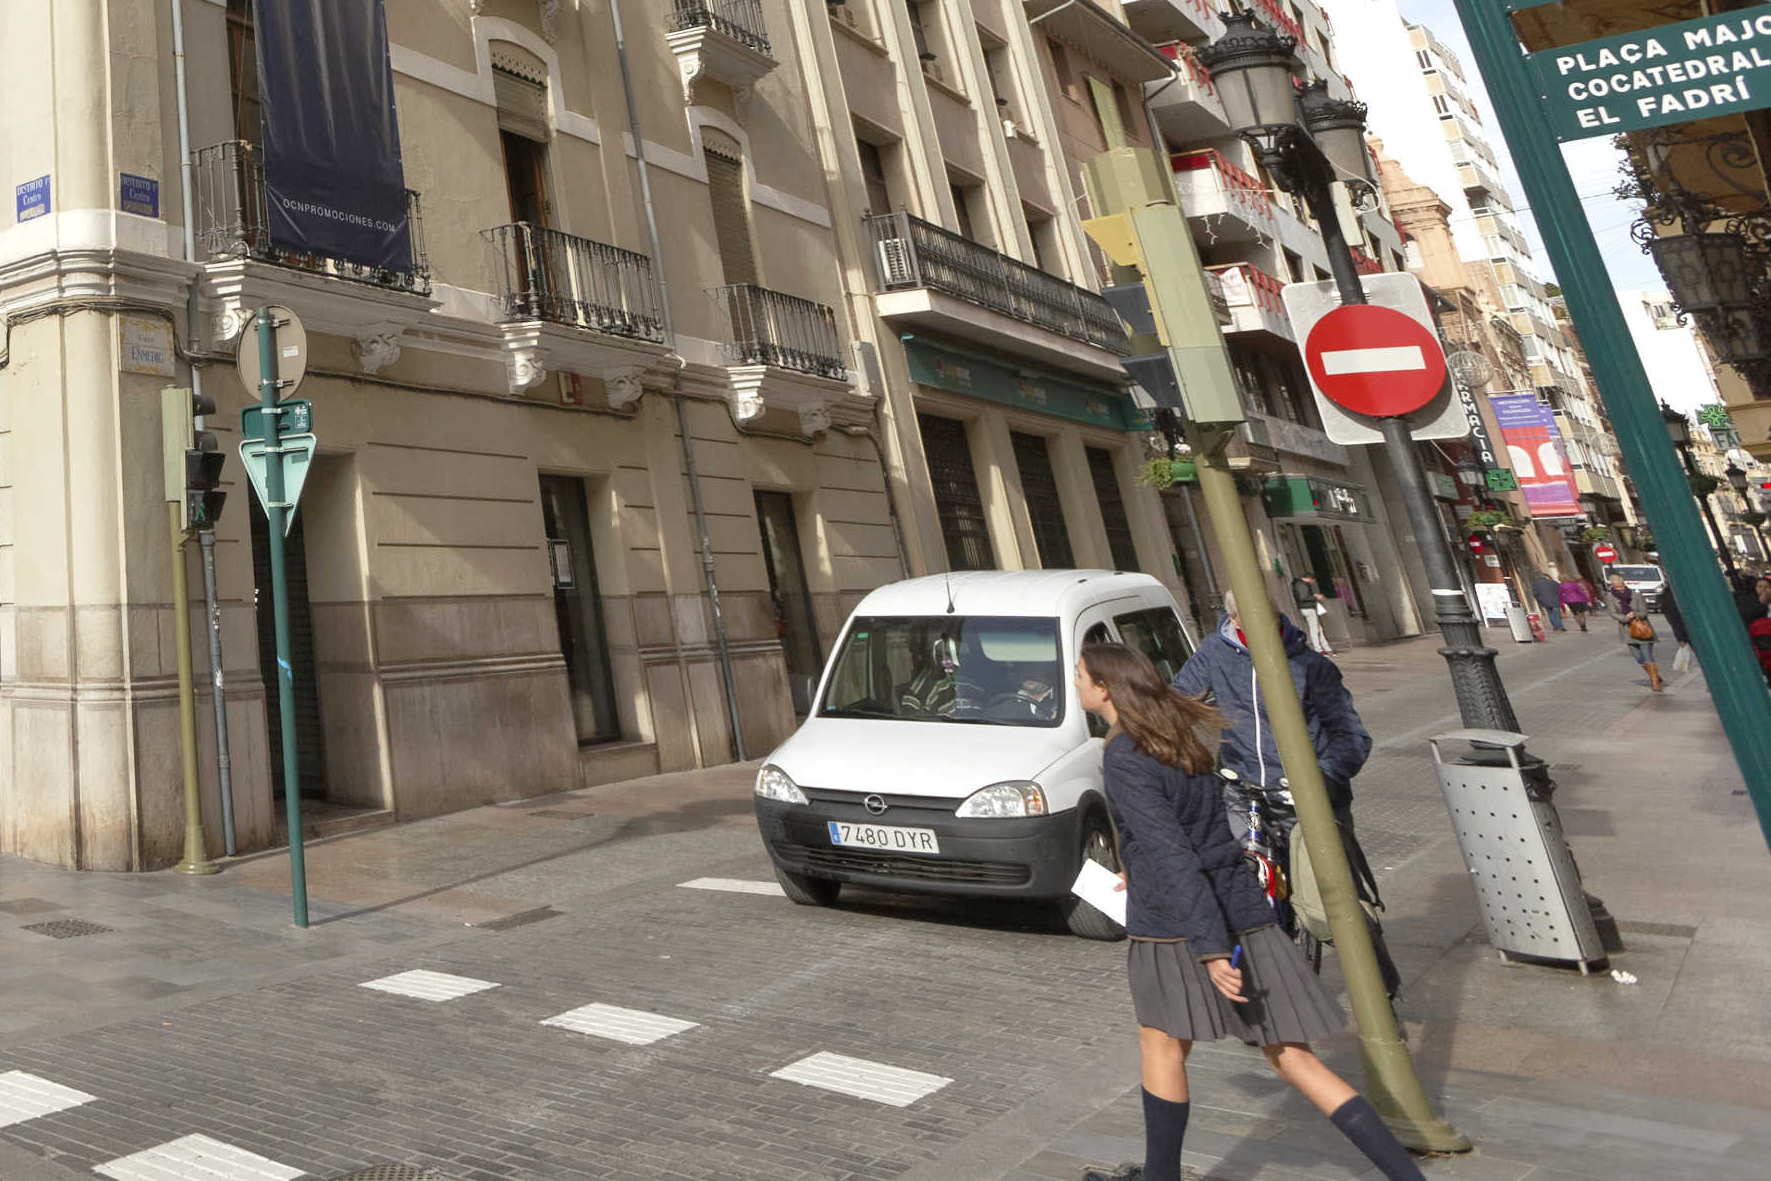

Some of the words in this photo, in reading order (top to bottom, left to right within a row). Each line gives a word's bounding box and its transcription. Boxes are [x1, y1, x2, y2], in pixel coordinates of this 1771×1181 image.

[1556, 38, 1668, 76] PLAÇA
[1568, 47, 1771, 101] COCATEDRAL
[1576, 106, 1620, 129] EL
[1636, 75, 1751, 118] FADRÍ
[23, 192, 42, 206] Centro
[129, 188, 150, 203] Centro
[283, 198, 397, 234] OCNPROMOCIONES.COM
[840, 825, 889, 846] 7480
[894, 830, 933, 850] DYR
